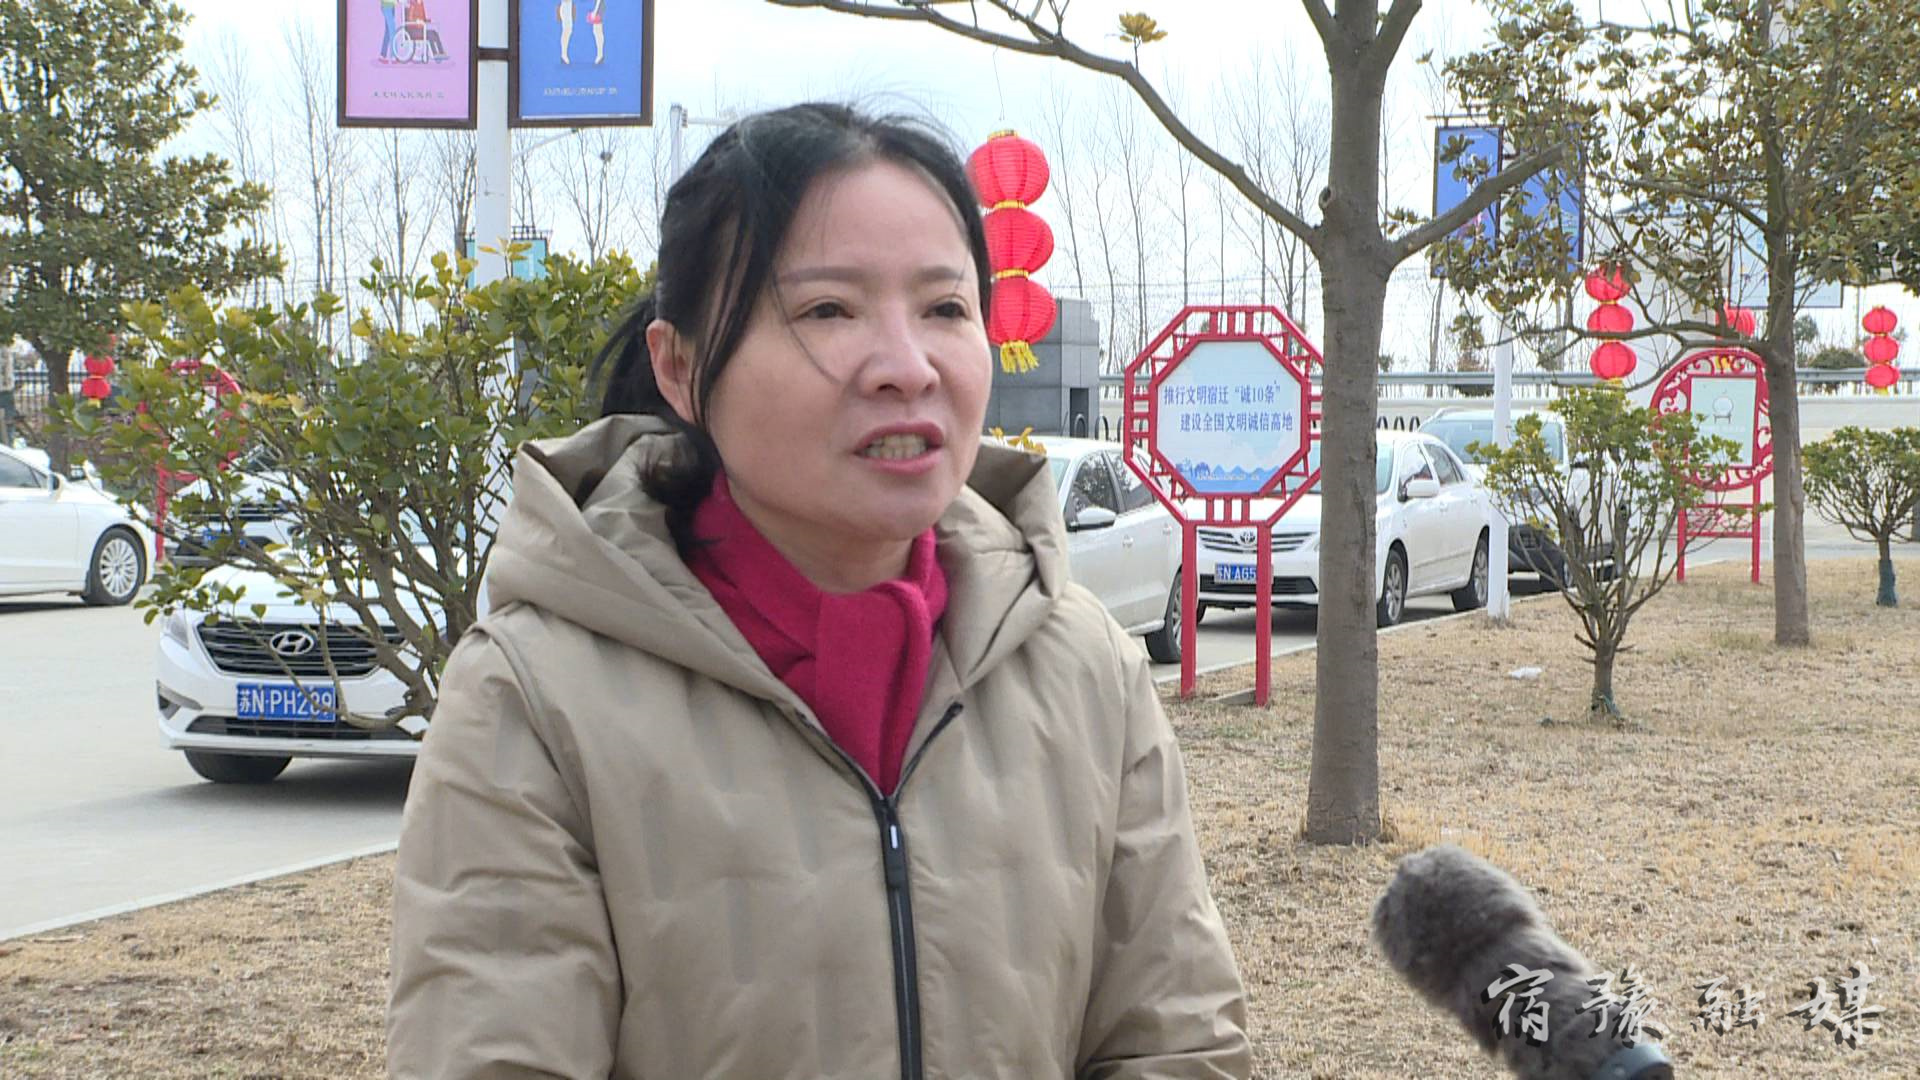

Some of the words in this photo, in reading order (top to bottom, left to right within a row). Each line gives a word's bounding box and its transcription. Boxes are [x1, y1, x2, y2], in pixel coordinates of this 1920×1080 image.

[1180, 411, 1293, 432] 建设全国文明诚信高地
